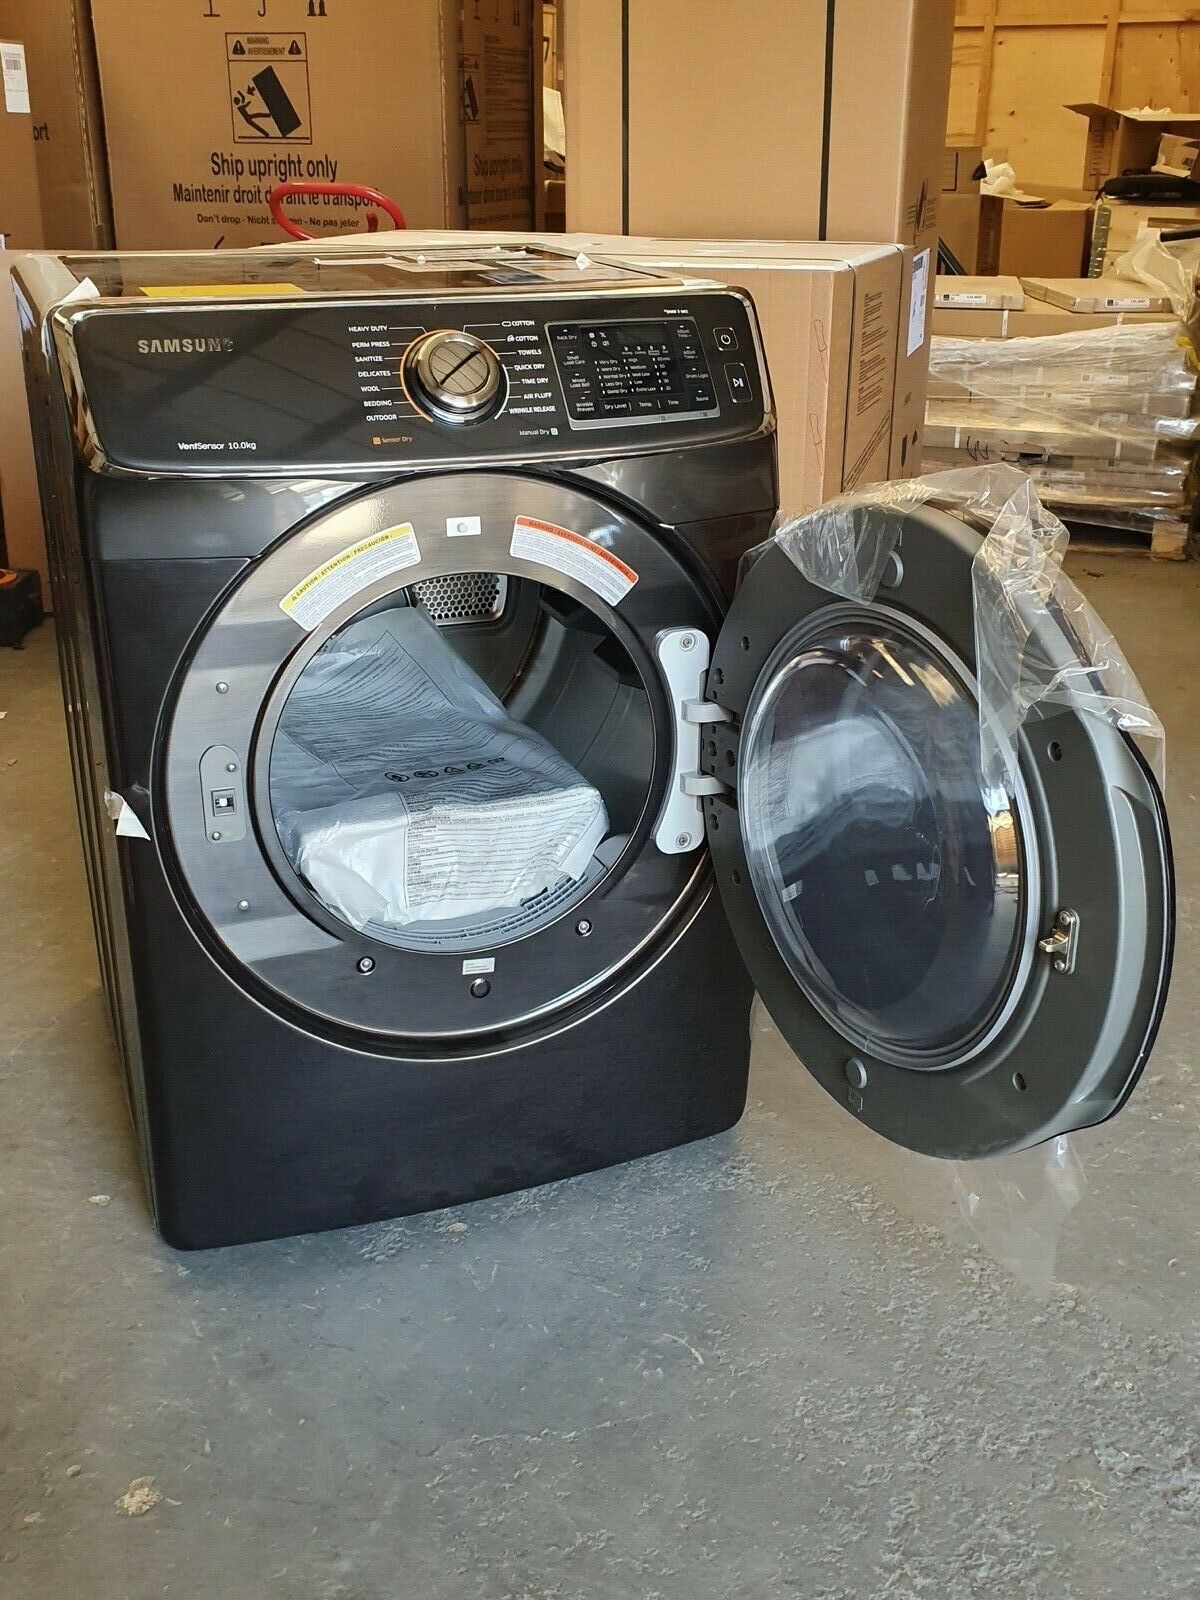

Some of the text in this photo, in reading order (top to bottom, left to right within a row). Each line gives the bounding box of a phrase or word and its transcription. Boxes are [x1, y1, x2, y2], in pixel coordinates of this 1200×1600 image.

[210, 152, 338, 182] Ship upright only
[172, 183, 230, 203] Maintenir
[233, 185, 262, 204] droit
[196, 213, 221, 224] Don't
[221, 214, 241, 225] drop
[247, 214, 270, 225] Nicht
[309, 217, 321, 226] Ne
[322, 218, 338, 229] pas
[339, 218, 360, 228] jeter
[539, 428, 550, 436] Dry
[177, 441, 257, 450] VentSensor 10.0kg
[295, 575, 320, 598] CAUTION
[320, 554, 351, 576] ATTENTION
